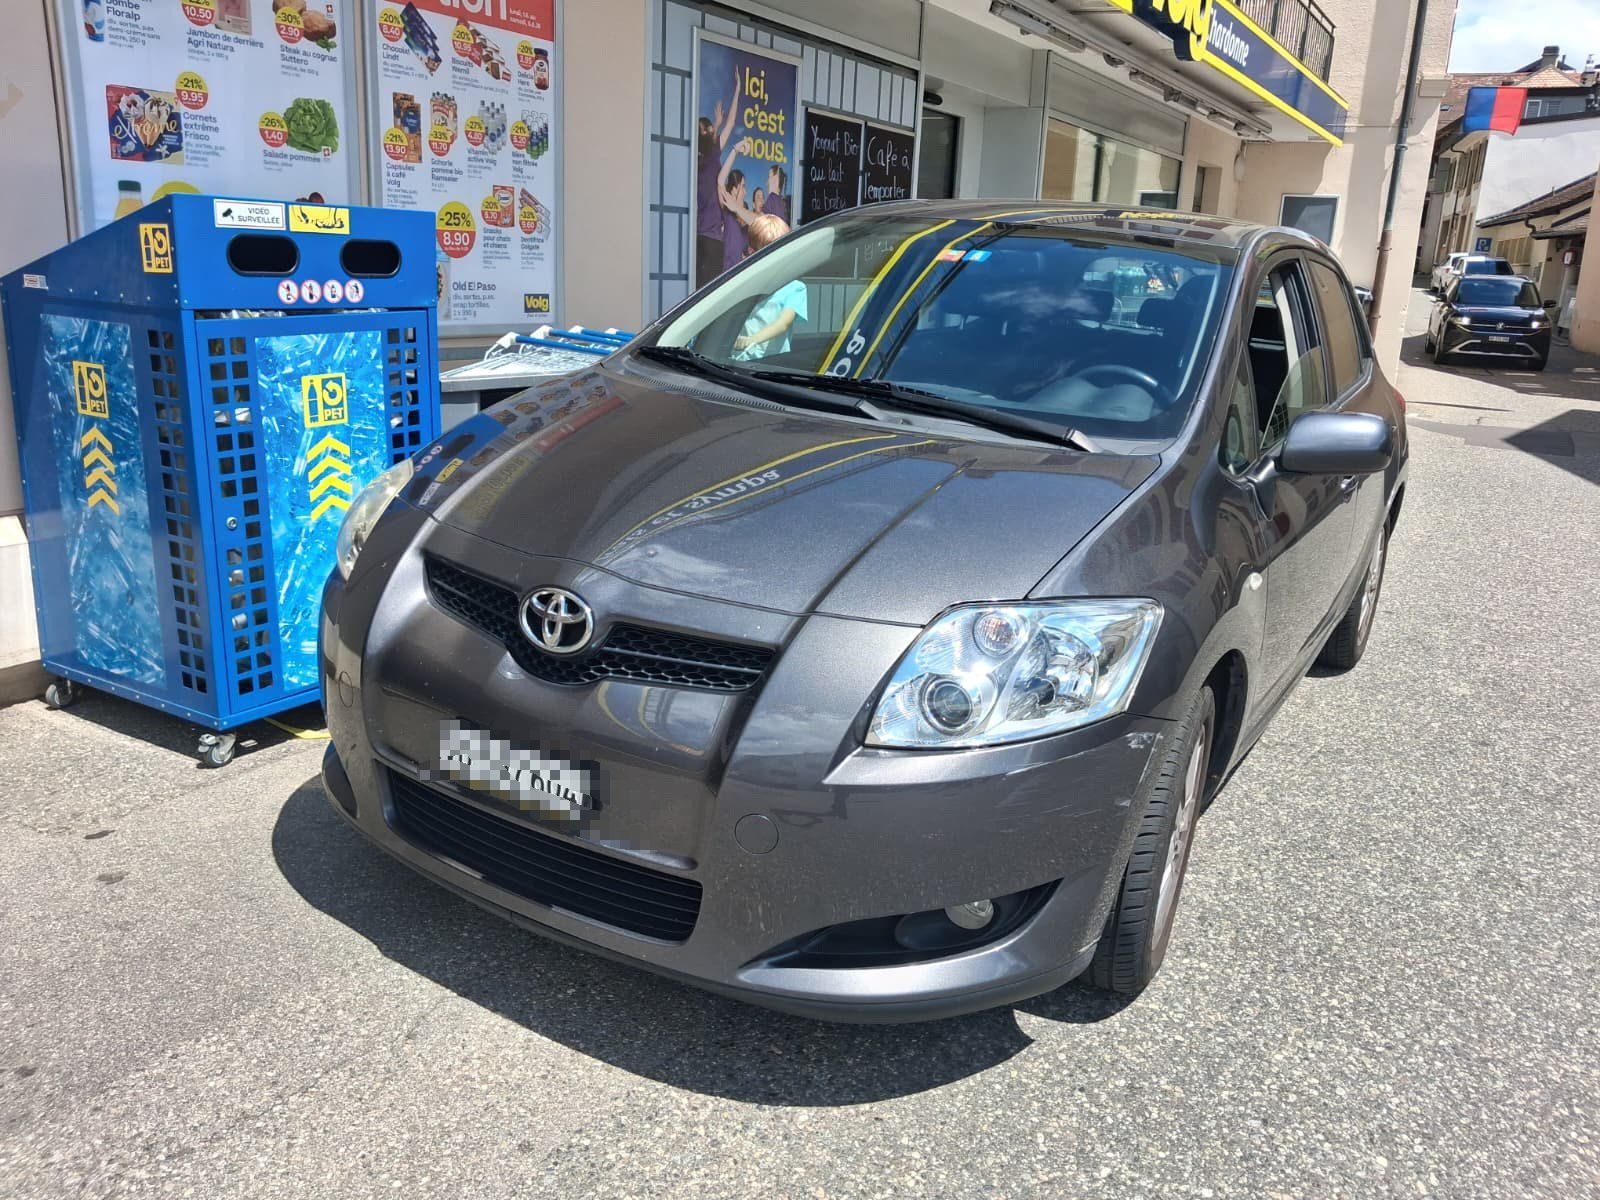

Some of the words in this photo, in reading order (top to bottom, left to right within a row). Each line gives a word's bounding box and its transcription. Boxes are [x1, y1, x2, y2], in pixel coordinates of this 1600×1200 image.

[106, 6, 141, 21] Floralp
[185, 6, 212, 19] 10.50
[277, 12, 301, 25] -30%
[380, 12, 401, 25] -20%
[279, 25, 300, 37] 2.90
[382, 25, 400, 36] 8.40
[453, 30, 471, 41] -20%
[186, 28, 220, 40] Jambon
[222, 34, 231, 42] de
[233, 36, 264, 48] derrière
[1206, 7, 1249, 67] hardonne
[187, 37, 204, 48] Agri
[206, 40, 235, 52] Natura
[280, 45, 300, 55] Steak
[312, 51, 338, 62] cognac
[382, 52, 400, 62] Lindt
[280, 54, 309, 66] Suttero
[179, 77, 203, 90] -21%
[744, 66, 769, 105] Ici,
[181, 90, 204, 103] 9.95
[182, 112, 217, 123] Cornets
[260, 117, 285, 129] -26%
[743, 104, 785, 136] c'est
[183, 123, 219, 133] extrême
[184, 131, 209, 141] Frisco
[264, 130, 283, 141] 1.40
[386, 133, 404, 143] -21%
[385, 144, 406, 154] 13.90
[431, 142, 448, 151] 11.70
[743, 135, 788, 164] nous.
[844, 131, 859, 156] Bio
[263, 149, 288, 159] Salade
[867, 135, 898, 176] Café
[386, 163, 415, 172] Capsules
[454, 168, 463, 176] bio
[386, 178, 401, 188] Volg
[247, 207, 270, 216] VIDÉO
[238, 215, 281, 225] SURVEILLÉE
[440, 211, 471, 227] -25%
[443, 231, 470, 246] 8.90
[156, 257, 169, 268] PET
[452, 281, 467, 291] Old
[468, 281, 476, 291] El
[477, 281, 497, 291] Paso
[525, 295, 549, 312] Volg
[90, 399, 105, 412] PET
[324, 407, 344, 420] PET
